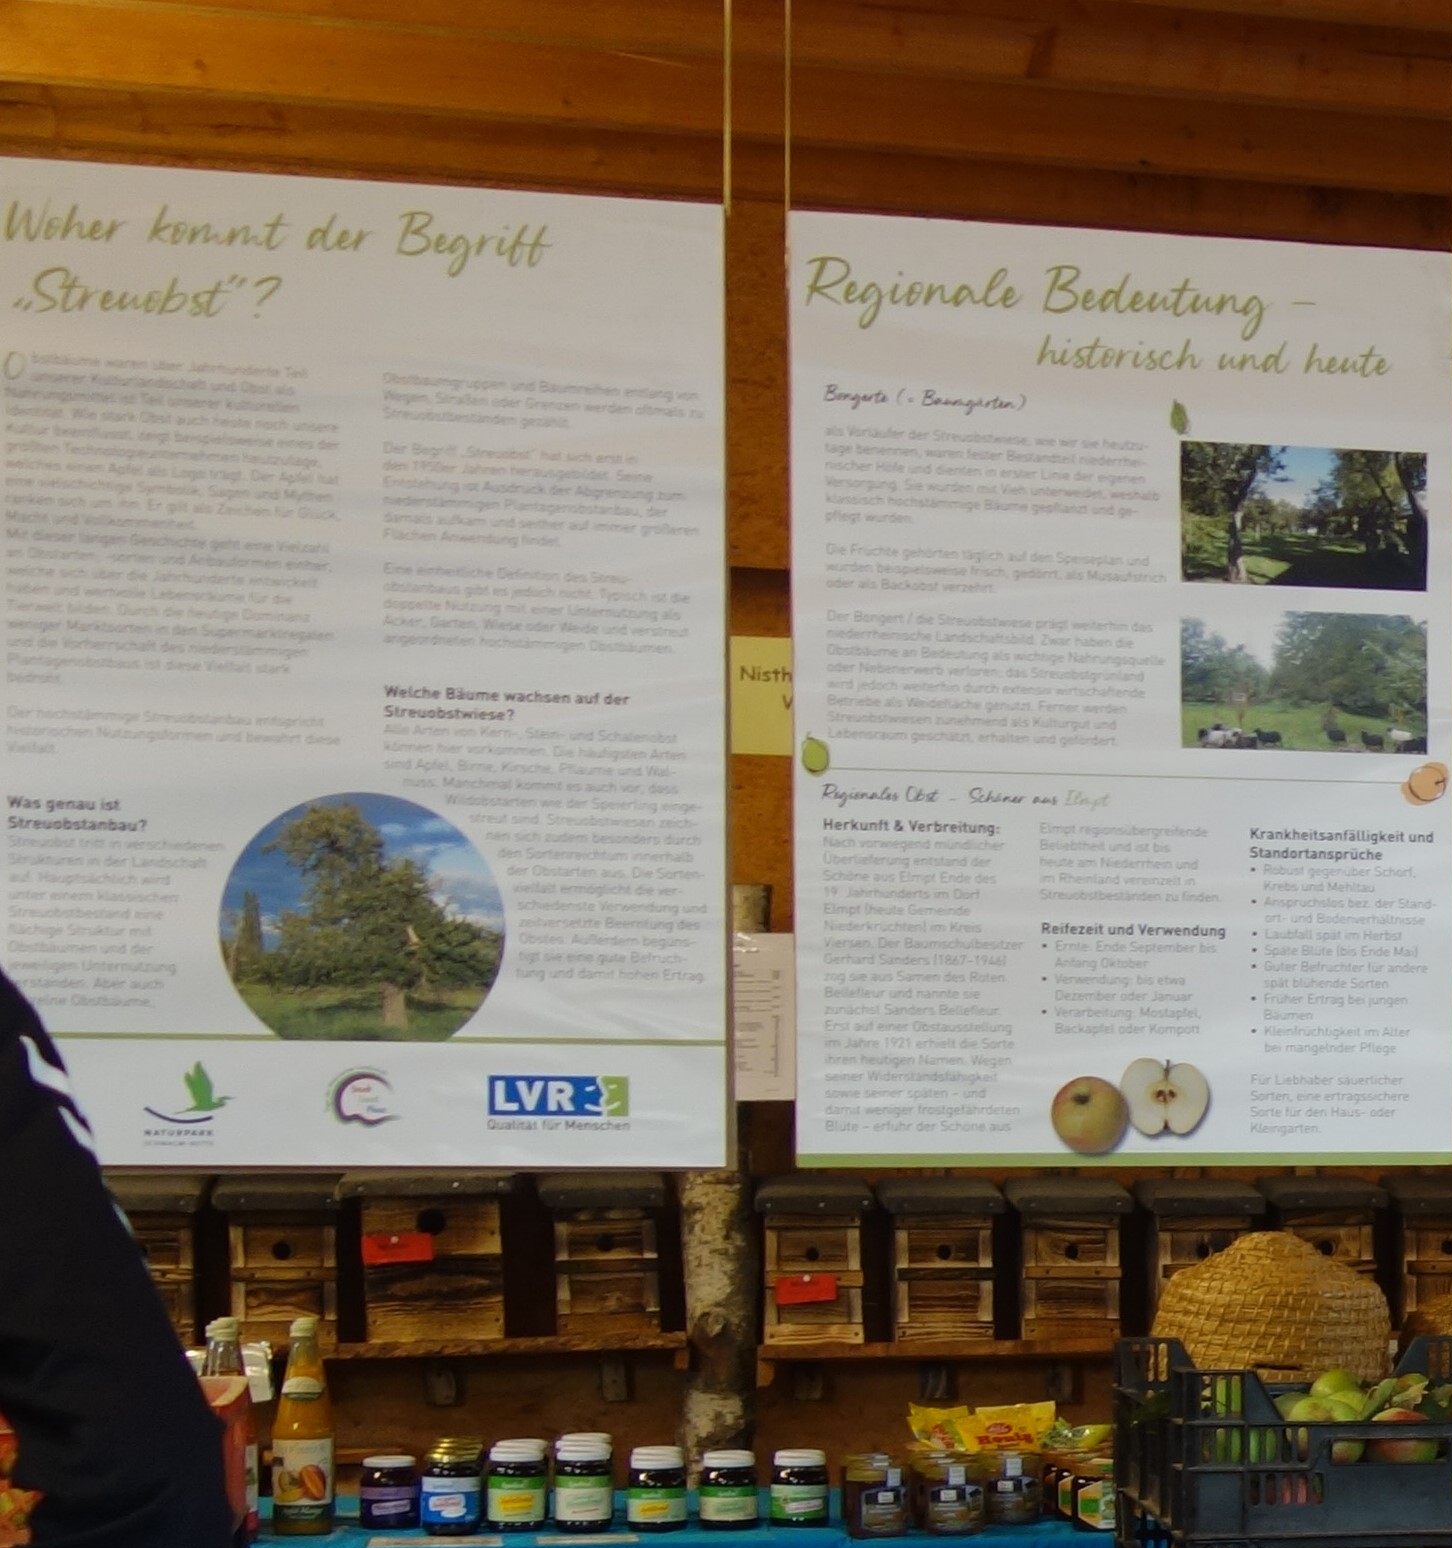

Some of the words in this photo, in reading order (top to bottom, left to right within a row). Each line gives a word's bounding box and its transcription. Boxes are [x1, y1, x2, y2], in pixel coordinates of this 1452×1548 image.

[2, 200, 120, 242] Woher
[147, 204, 286, 251] kommt
[305, 214, 367, 252] der
[395, 208, 550, 279] Begriff
[805, 255, 1019, 330] Regionale
[1042, 264, 1267, 343] Bedeutung
[1035, 334, 1200, 372] historisch
[1217, 347, 1285, 374] und
[1303, 343, 1389, 378] heute
[383, 685, 441, 700] Welche
[445, 686, 500, 702] Bäume
[503, 690, 571, 704] wachsen
[574, 692, 600, 705] auf
[603, 693, 630, 706] der
[383, 704, 515, 721] Streuobstwiese?
[7, 796, 40, 810] Was
[45, 799, 96, 813] genau
[100, 799, 120, 812] ist
[821, 782, 899, 809] Regionales
[905, 785, 939, 803] Obst
[968, 786, 1025, 804] Schöner
[1031, 795, 1058, 806] aus
[7, 815, 148, 832] Streuobstanbau?
[822, 818, 889, 832] Herkunft
[893, 819, 904, 832] &
[908, 819, 1000, 837] Verbreitung:
[1249, 827, 1405, 848] Krankheitsanfälligkeit
[1408, 831, 1434, 844] und
[1249, 845, 1383, 863] Standortansprüche
[1041, 921, 1104, 936] Reifezeit
[1107, 924, 1135, 936] und
[1137, 924, 1226, 940] Verwendung
[492, 1080, 575, 1112] LVR
[486, 1118, 538, 1131] Qualität
[542, 1118, 562, 1131] für
[564, 1116, 631, 1131] Menschen
